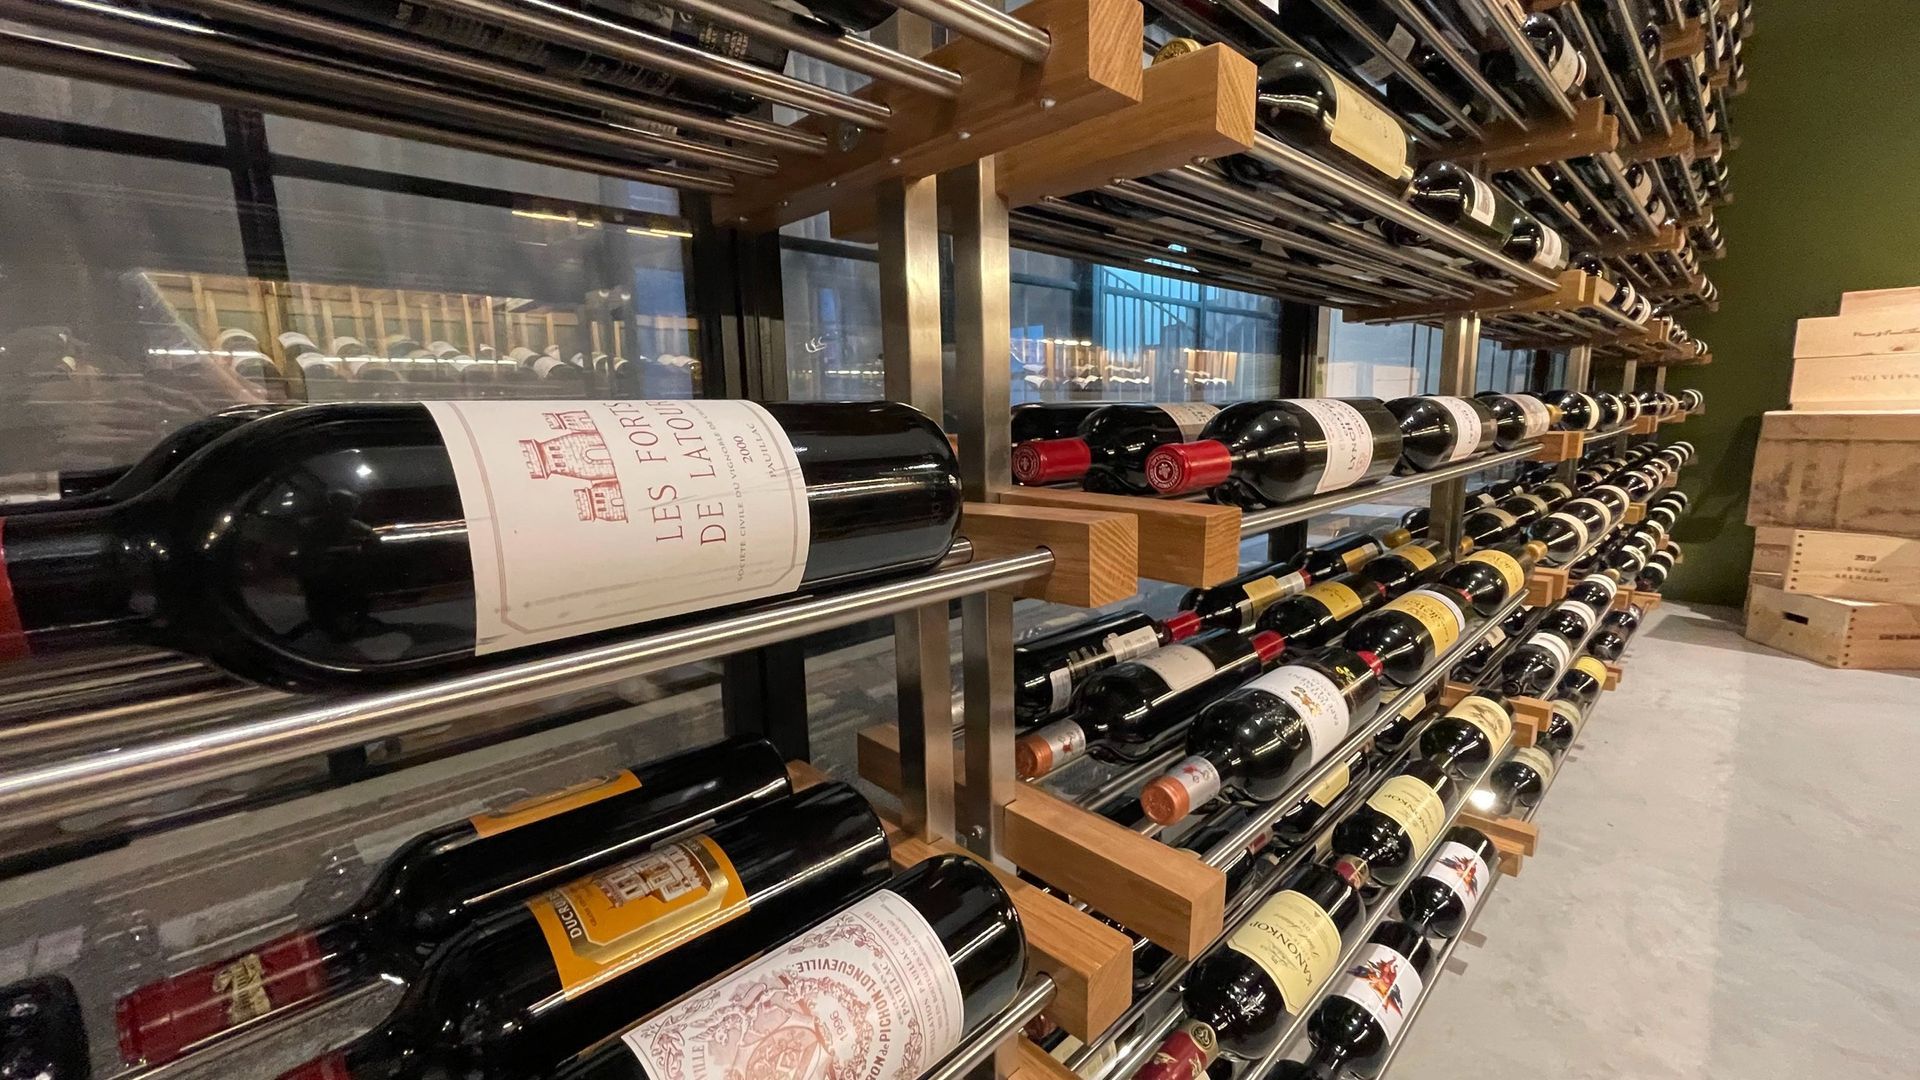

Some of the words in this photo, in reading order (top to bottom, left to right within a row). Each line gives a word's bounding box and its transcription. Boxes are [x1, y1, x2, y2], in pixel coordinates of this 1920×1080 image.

[603, 402, 668, 463] FORTS
[733, 435, 754, 464] 2000
[746, 423, 777, 478] PAUILLAC
[1344, 423, 1357, 469] LYNCH
[714, 432, 737, 479] VIGNOBLE
[733, 482, 742, 498] DU
[648, 485, 683, 542] LES
[697, 502, 726, 546] DE
[737, 502, 746, 537] CIVILE
[899, 949, 926, 994] PAUILLAC
[1248, 920, 1312, 987] KANONKOP
[880, 962, 910, 1016] PAUILLAC
[829, 1011, 848, 1041] 1996
[879, 1043, 889, 1056] de
